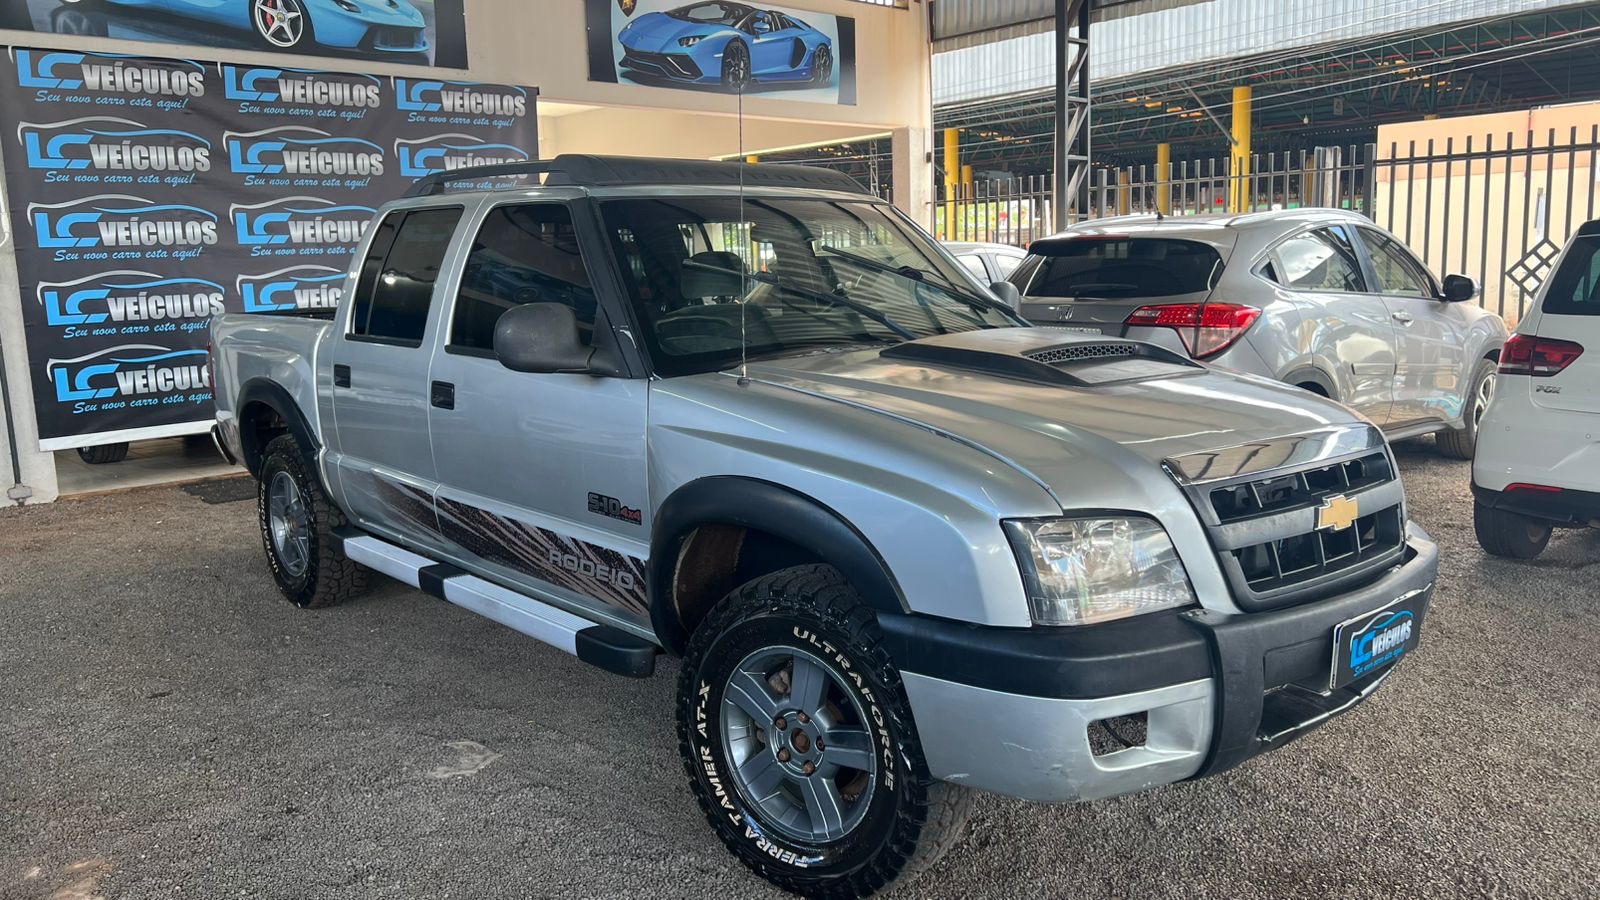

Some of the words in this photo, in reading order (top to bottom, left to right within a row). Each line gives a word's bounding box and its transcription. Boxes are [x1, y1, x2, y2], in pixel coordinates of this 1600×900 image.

[16, 50, 86, 89] LC
[81, 61, 205, 97] VEÍCULOS
[223, 66, 282, 102] LC
[278, 76, 380, 108] VEÍCULOS
[35, 90, 60, 102] Seu
[65, 95, 91, 103] novo
[95, 96, 126, 105] carro
[239, 102, 261, 114] Seu
[264, 106, 285, 114] novo
[288, 107, 314, 117] carro
[396, 79, 445, 112] LC
[440, 89, 526, 117] VEÍCULOS
[407, 112, 426, 123] Seu
[428, 116, 448, 124] novo
[449, 117, 471, 125] carro
[25, 132, 94, 169] LC
[89, 140, 211, 172] VEÍCULOS
[229, 140, 287, 174] LC
[283, 147, 384, 176] VEÍCULOS
[44, 171, 70, 183] Seu
[74, 175, 100, 183] novo
[104, 175, 134, 184] carro
[244, 175, 266, 186] Seu
[269, 178, 291, 187] novo
[293, 178, 320, 187] carro
[34, 212, 103, 248] LC
[97, 216, 218, 246] VEÍCULOS
[235, 212, 292, 245] LC
[288, 216, 371, 243] VEÍCUL
[54, 250, 79, 262] Seu
[84, 252, 108, 260] novo
[112, 250, 142, 260] carro
[250, 246, 273, 257] Seu
[274, 247, 296, 256] novo
[299, 247, 324, 255] carro
[44, 289, 111, 326] LC
[107, 292, 226, 322] VEÍCULOS
[242, 281, 298, 313] LC
[294, 284, 342, 309] VEÍC
[63, 326, 88, 339] Seu
[93, 327, 117, 336] novo
[121, 324, 150, 335] carro
[54, 363, 120, 402] LC
[73, 401, 97, 414] Seu
[102, 400, 126, 411] novo
[129, 396, 159, 408] carro
[549, 549, 634, 590] RODEIO
[1351, 630, 1376, 669] LC
[697, 679, 711, 739] AT-X
[794, 626, 894, 791] ULTRAFORCE
[700, 745, 742, 826] TAMER
